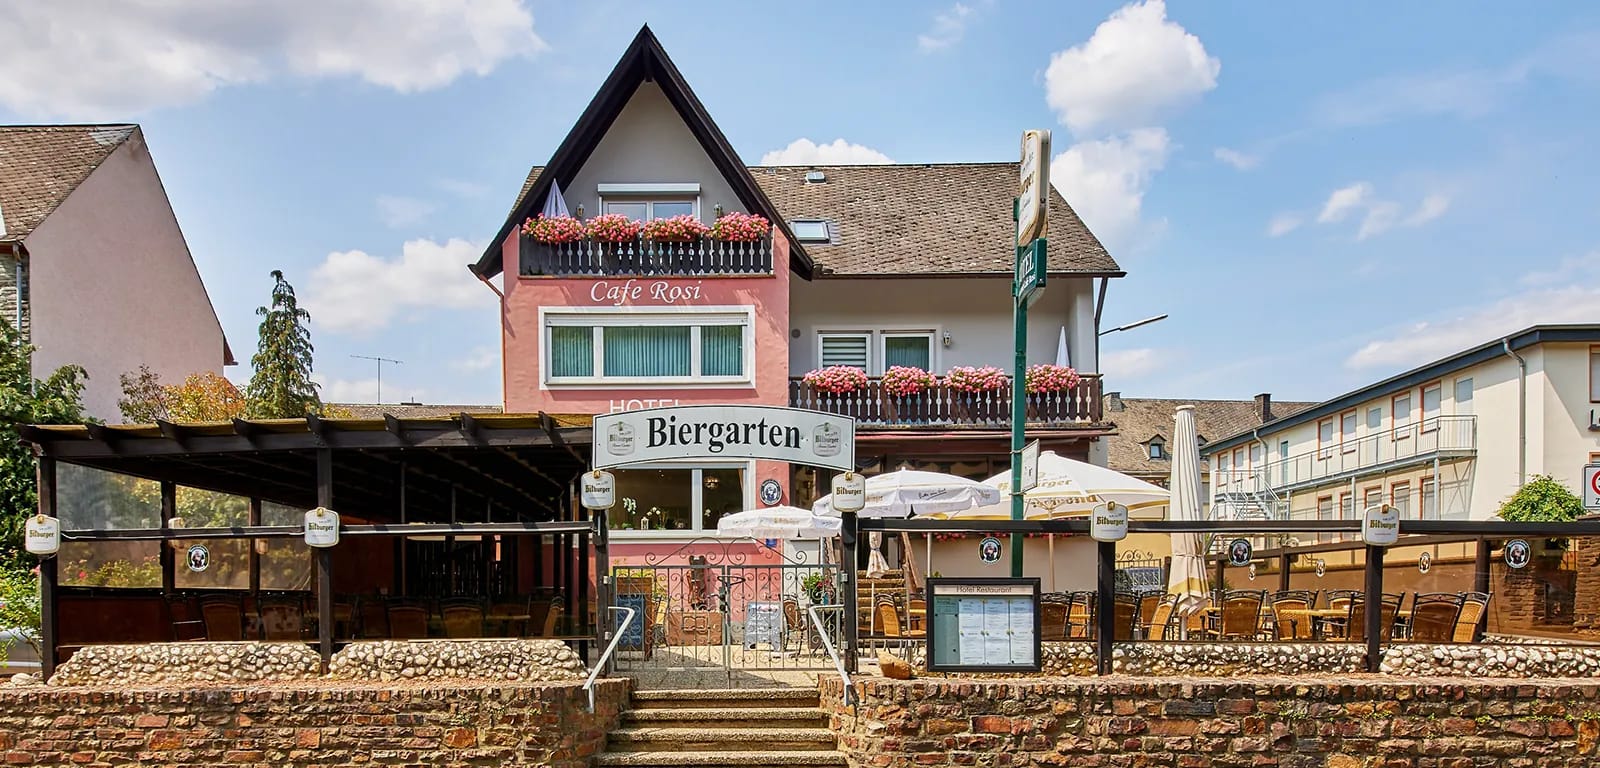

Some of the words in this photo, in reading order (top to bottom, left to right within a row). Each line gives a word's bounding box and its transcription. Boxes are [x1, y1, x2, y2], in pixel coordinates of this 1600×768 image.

[590, 279, 642, 306] Cafe
[650, 280, 702, 304] Rosi
[646, 415, 801, 453] Biergarten
[956, 585, 975, 593] Hotel
[976, 585, 1012, 593] Restaurant
